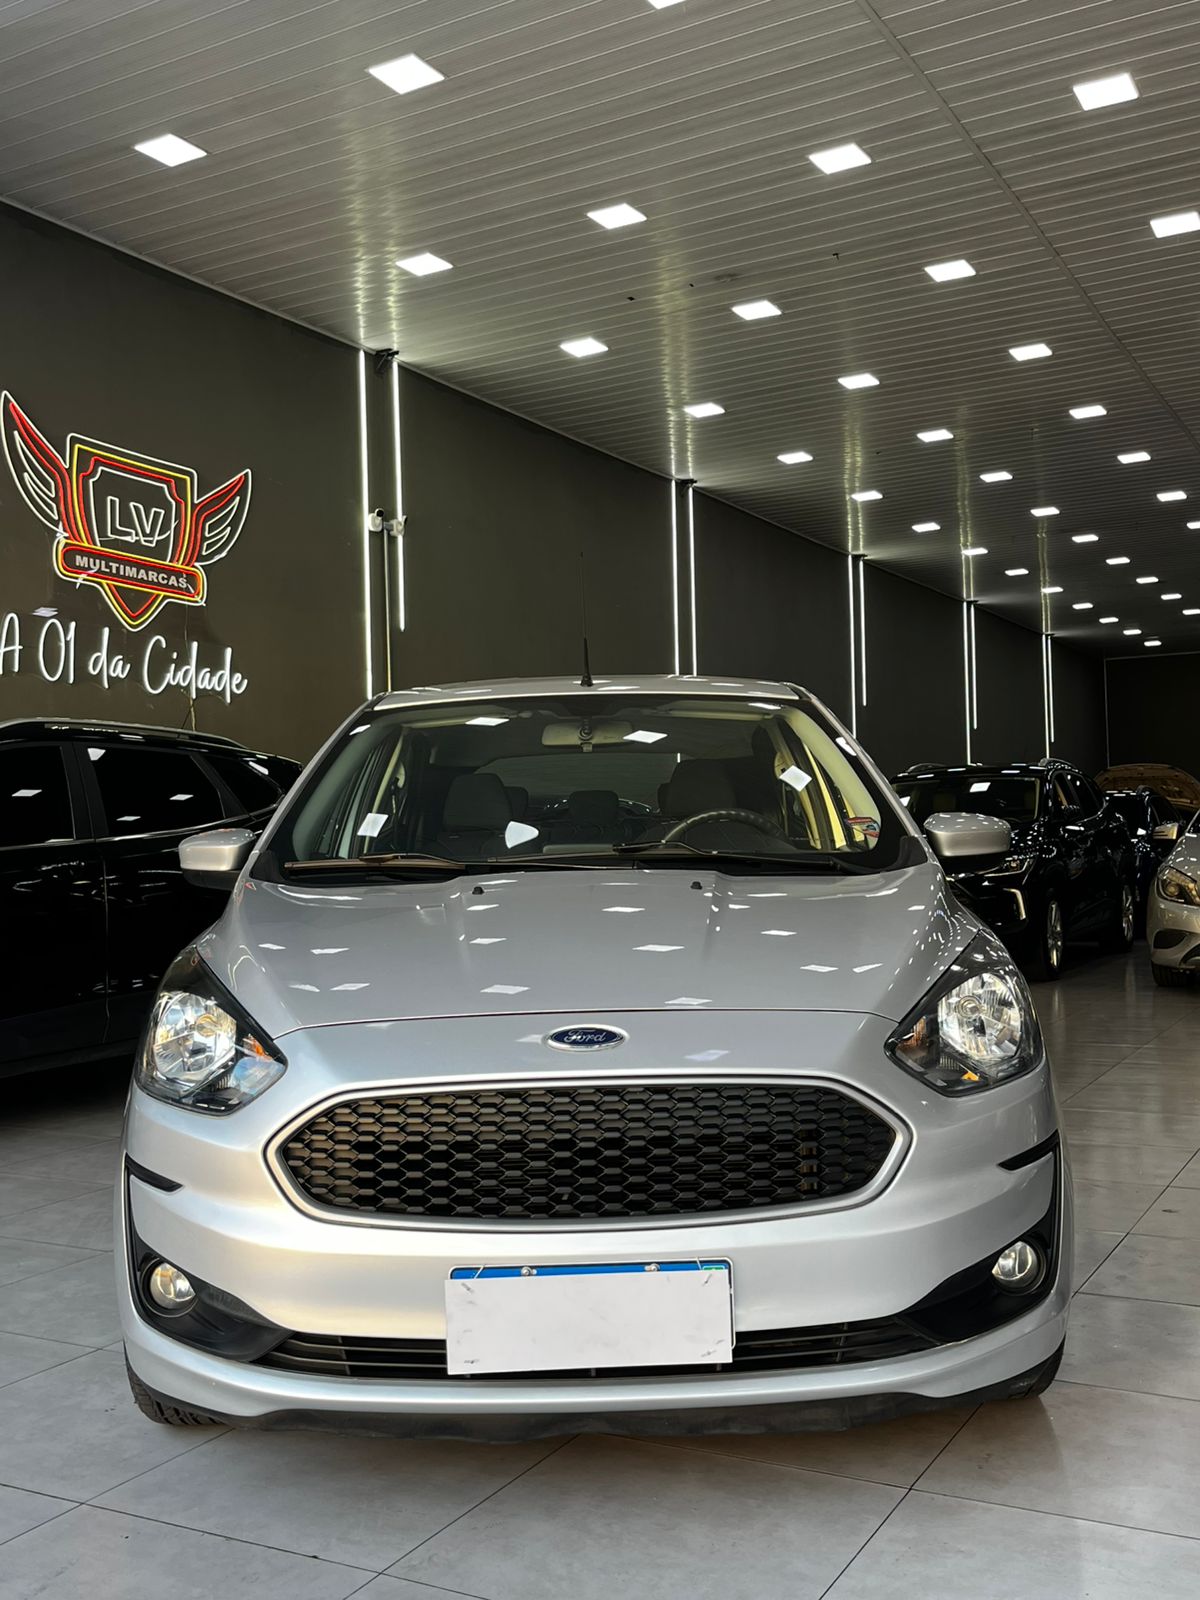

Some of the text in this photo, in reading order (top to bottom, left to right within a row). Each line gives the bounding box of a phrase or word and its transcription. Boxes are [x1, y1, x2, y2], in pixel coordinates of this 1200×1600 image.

[107, 496, 165, 547] LV
[75, 555, 188, 589] MULTIMARCAS
[0, 612, 23, 675] A
[88, 627, 131, 689] da
[143, 635, 248, 704] Cidade
[563, 1029, 606, 1043] Ford
